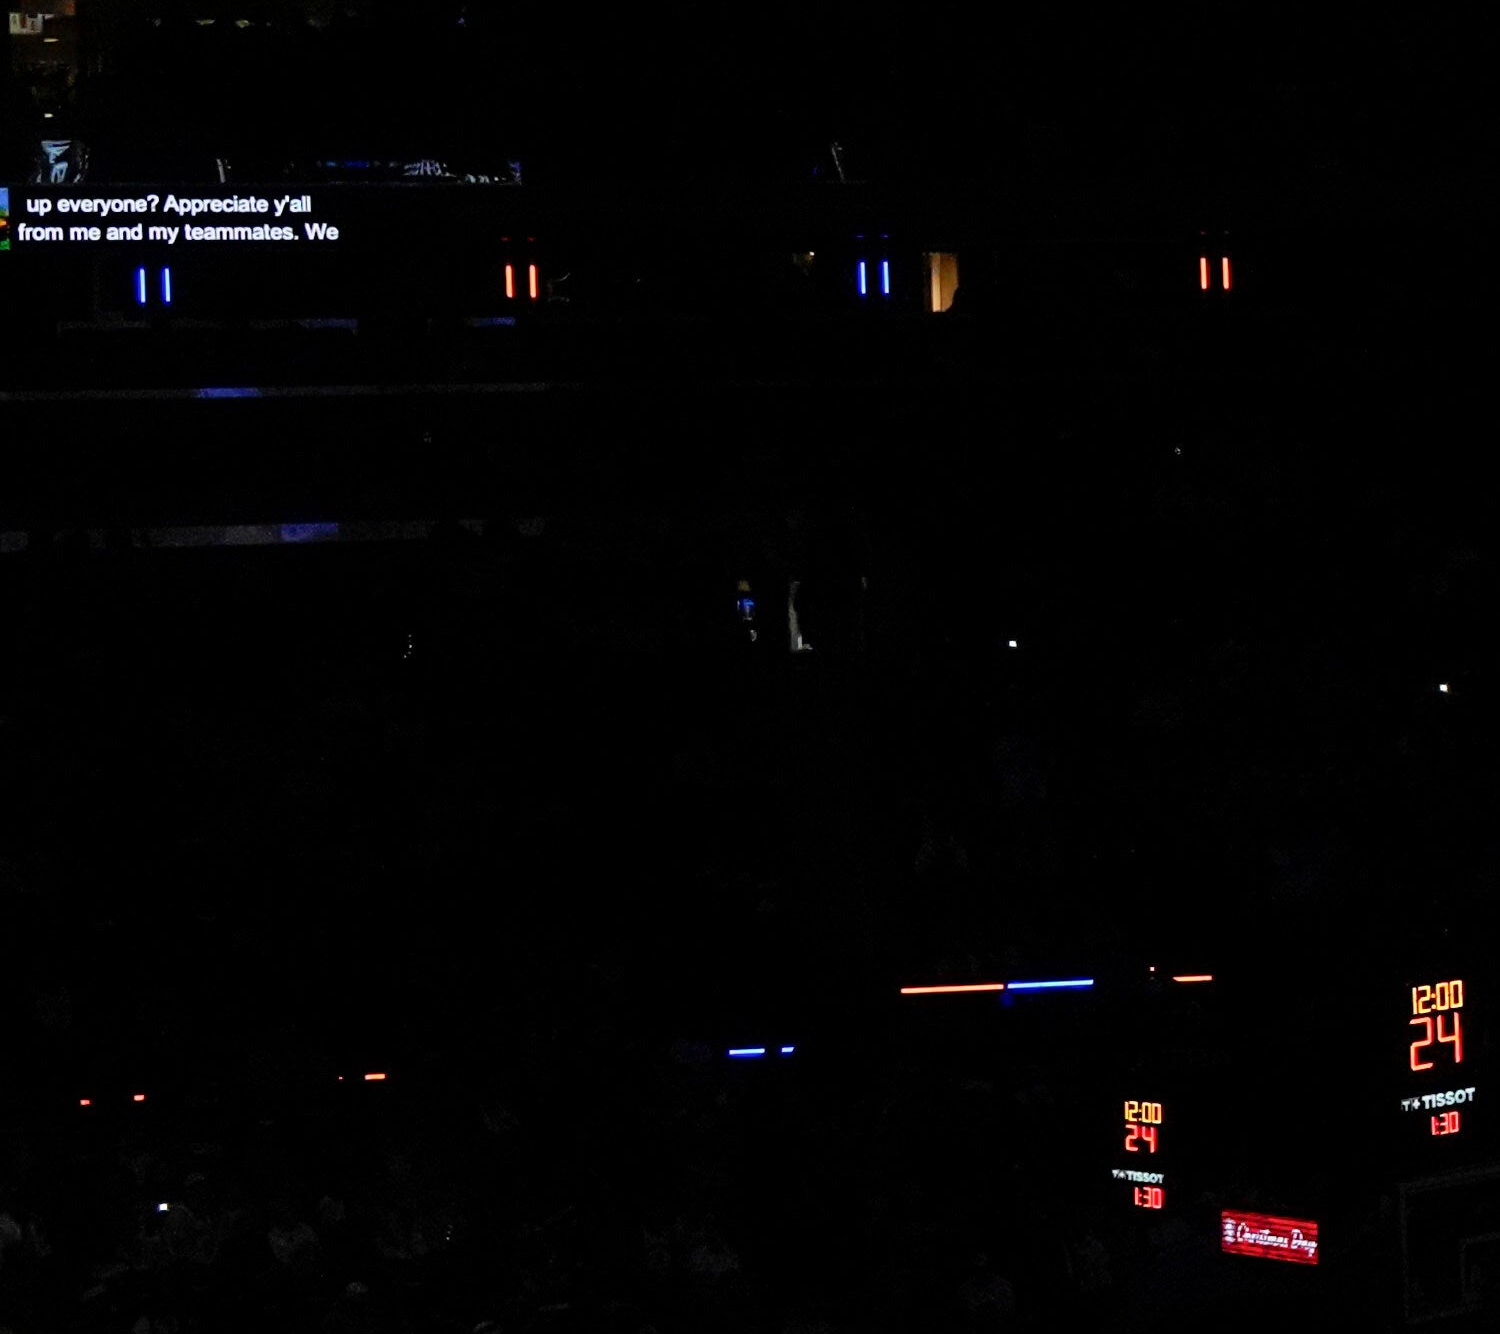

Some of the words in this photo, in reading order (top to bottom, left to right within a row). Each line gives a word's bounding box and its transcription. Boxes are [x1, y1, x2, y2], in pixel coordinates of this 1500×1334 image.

[26, 197, 52, 216] up
[57, 195, 160, 216] everyone?
[163, 195, 268, 216] Appreciate
[274, 195, 312, 216] y'all
[18, 223, 63, 241] from
[69, 226, 101, 241] me
[106, 224, 143, 241] and
[148, 226, 179, 244] my
[184, 224, 299, 241] teammates.
[304, 223, 339, 241] We
[1412, 980, 1464, 1014] 12:00
[1409, 1011, 1462, 1071] 24
[1422, 1087, 1476, 1110] TISSOT
[1124, 1100, 1162, 1124] 12:00
[1431, 1111, 1460, 1136] 1:30
[1125, 1124, 1157, 1153] 24
[1126, 1170, 1165, 1184] TISSOT
[1134, 1187, 1162, 1209] 1:30
[1237, 1222, 1289, 1248] Christmas
[1291, 1228, 1318, 1257] Day
